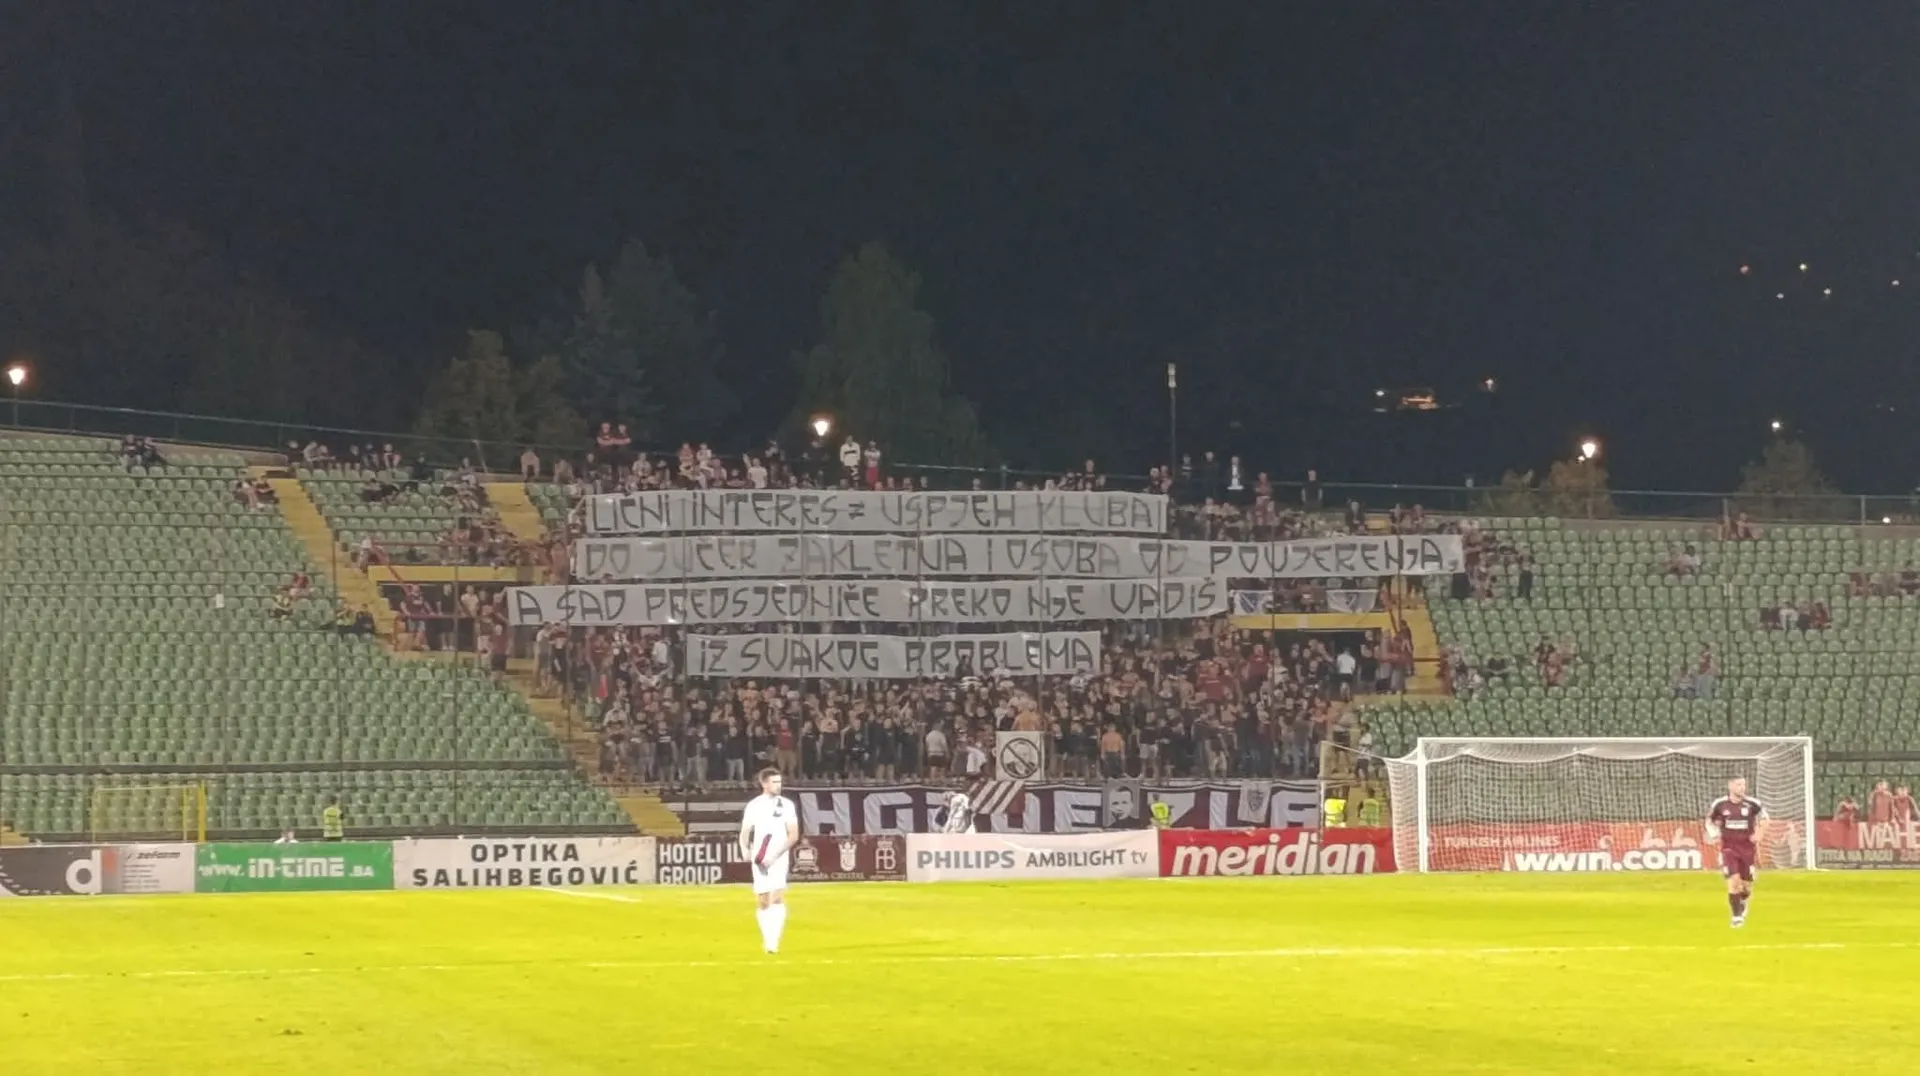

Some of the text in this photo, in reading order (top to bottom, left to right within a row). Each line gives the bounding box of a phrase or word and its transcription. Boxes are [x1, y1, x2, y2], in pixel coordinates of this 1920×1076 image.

[692, 492, 838, 527] INTERES
[881, 495, 1015, 527] USPJEH
[1037, 494, 1153, 527] KLUBA
[585, 543, 631, 576] DO
[1007, 539, 1121, 574] OSOBA
[1139, 543, 1188, 575] OD
[516, 590, 543, 623] A
[557, 589, 626, 621] SAD
[908, 587, 1012, 618] PREKO
[471, 843, 579, 862] OPTIKA
[660, 843, 722, 864] HOTELI
[1171, 832, 1376, 876] meridian
[1444, 837, 1499, 849] TURKISH
[917, 850, 1147, 869] PHILIPS AMBILIGHT tv
[1515, 850, 1701, 872] wwin.com
[413, 860, 638, 886] SALIHBEGOVIĆ
[660, 865, 722, 885] GROUP
